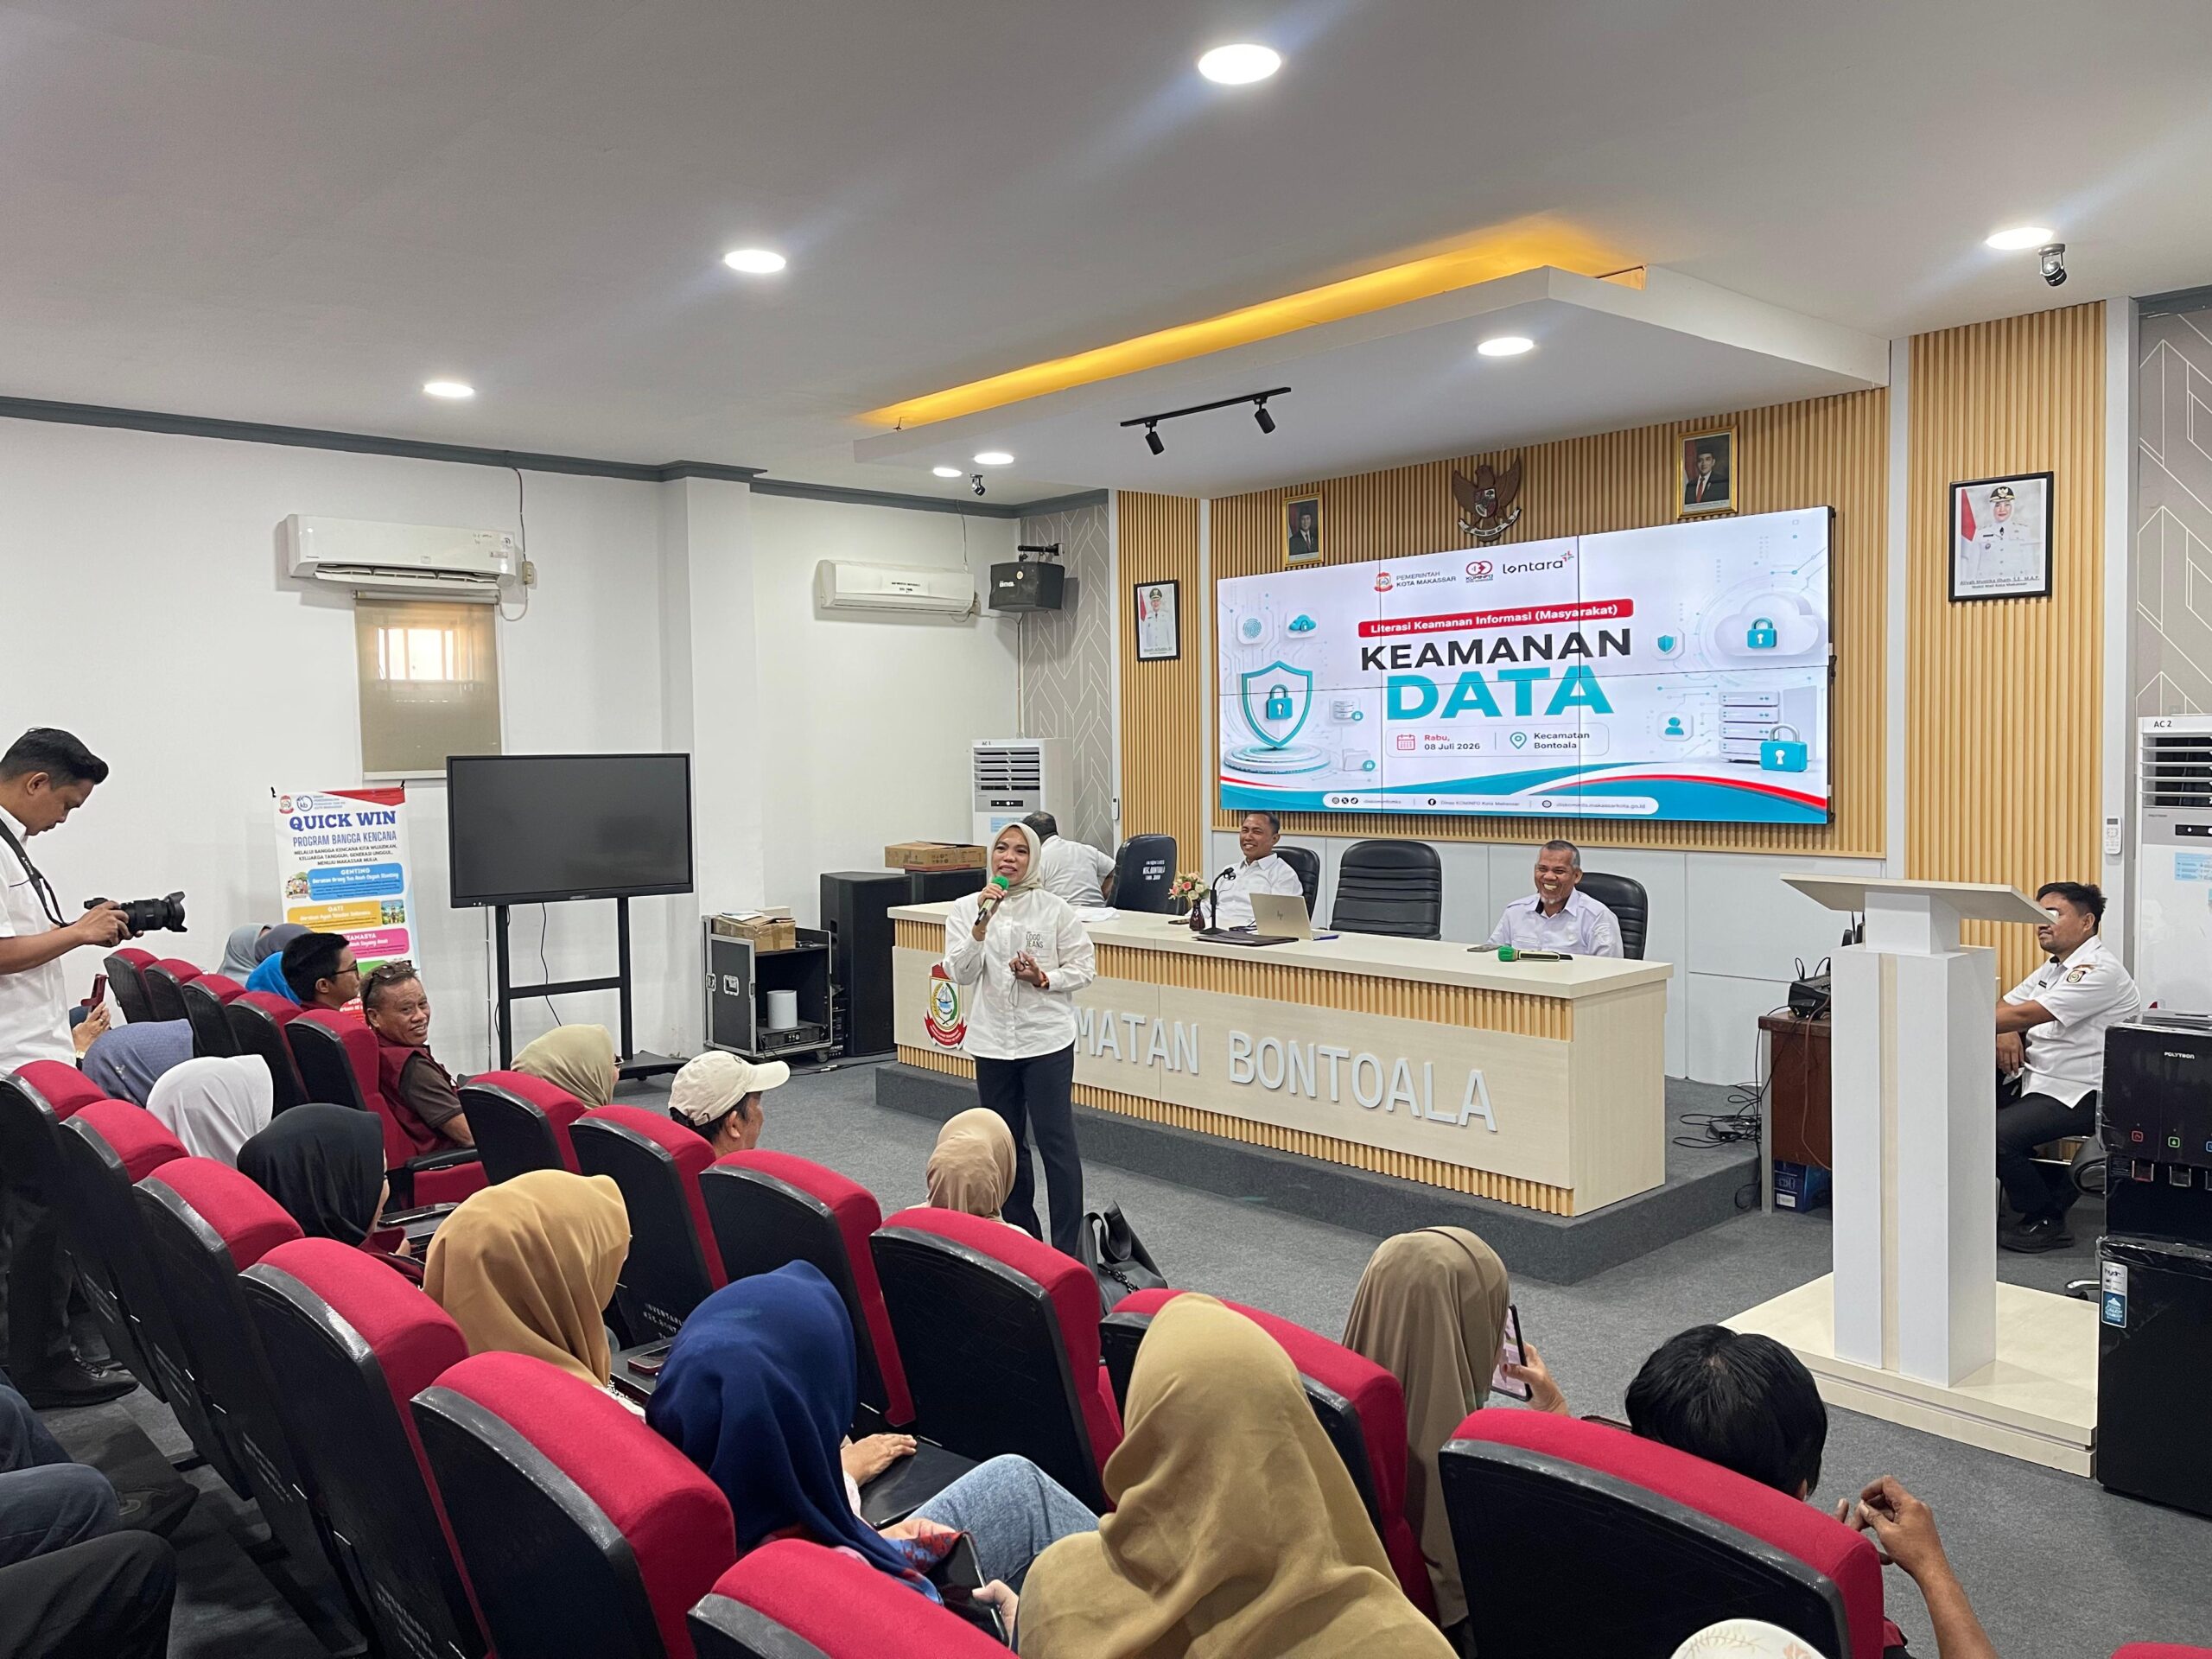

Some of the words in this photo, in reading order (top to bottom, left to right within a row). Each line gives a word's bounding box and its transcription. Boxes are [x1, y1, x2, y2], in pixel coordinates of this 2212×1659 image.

[1396, 571, 1440, 581] PEMERINTAH
[1503, 561, 1563, 575] lontara
[1416, 576, 1456, 586] MAKASSAR
[1370, 622, 1411, 633] Literasi
[1414, 618, 1472, 630] Keamanan
[1476, 611, 1532, 625] Informasi
[1535, 604, 1618, 622] (Masyarakat)
[1362, 628, 1631, 671] KEAMANAN
[1387, 664, 1614, 720] DATA
[1425, 734, 1450, 742] Rabu,
[1535, 732, 1590, 741] Kecamatan
[289, 814, 353, 831] QUICK
[356, 810, 396, 826] WIN
[293, 835, 329, 847] PROGRAM
[332, 833, 361, 844] BANGGA
[364, 830, 397, 843] KENCANA
[1074, 1006, 1199, 1074] MATAN
[1228, 1030, 1497, 1132] BONTOALA
